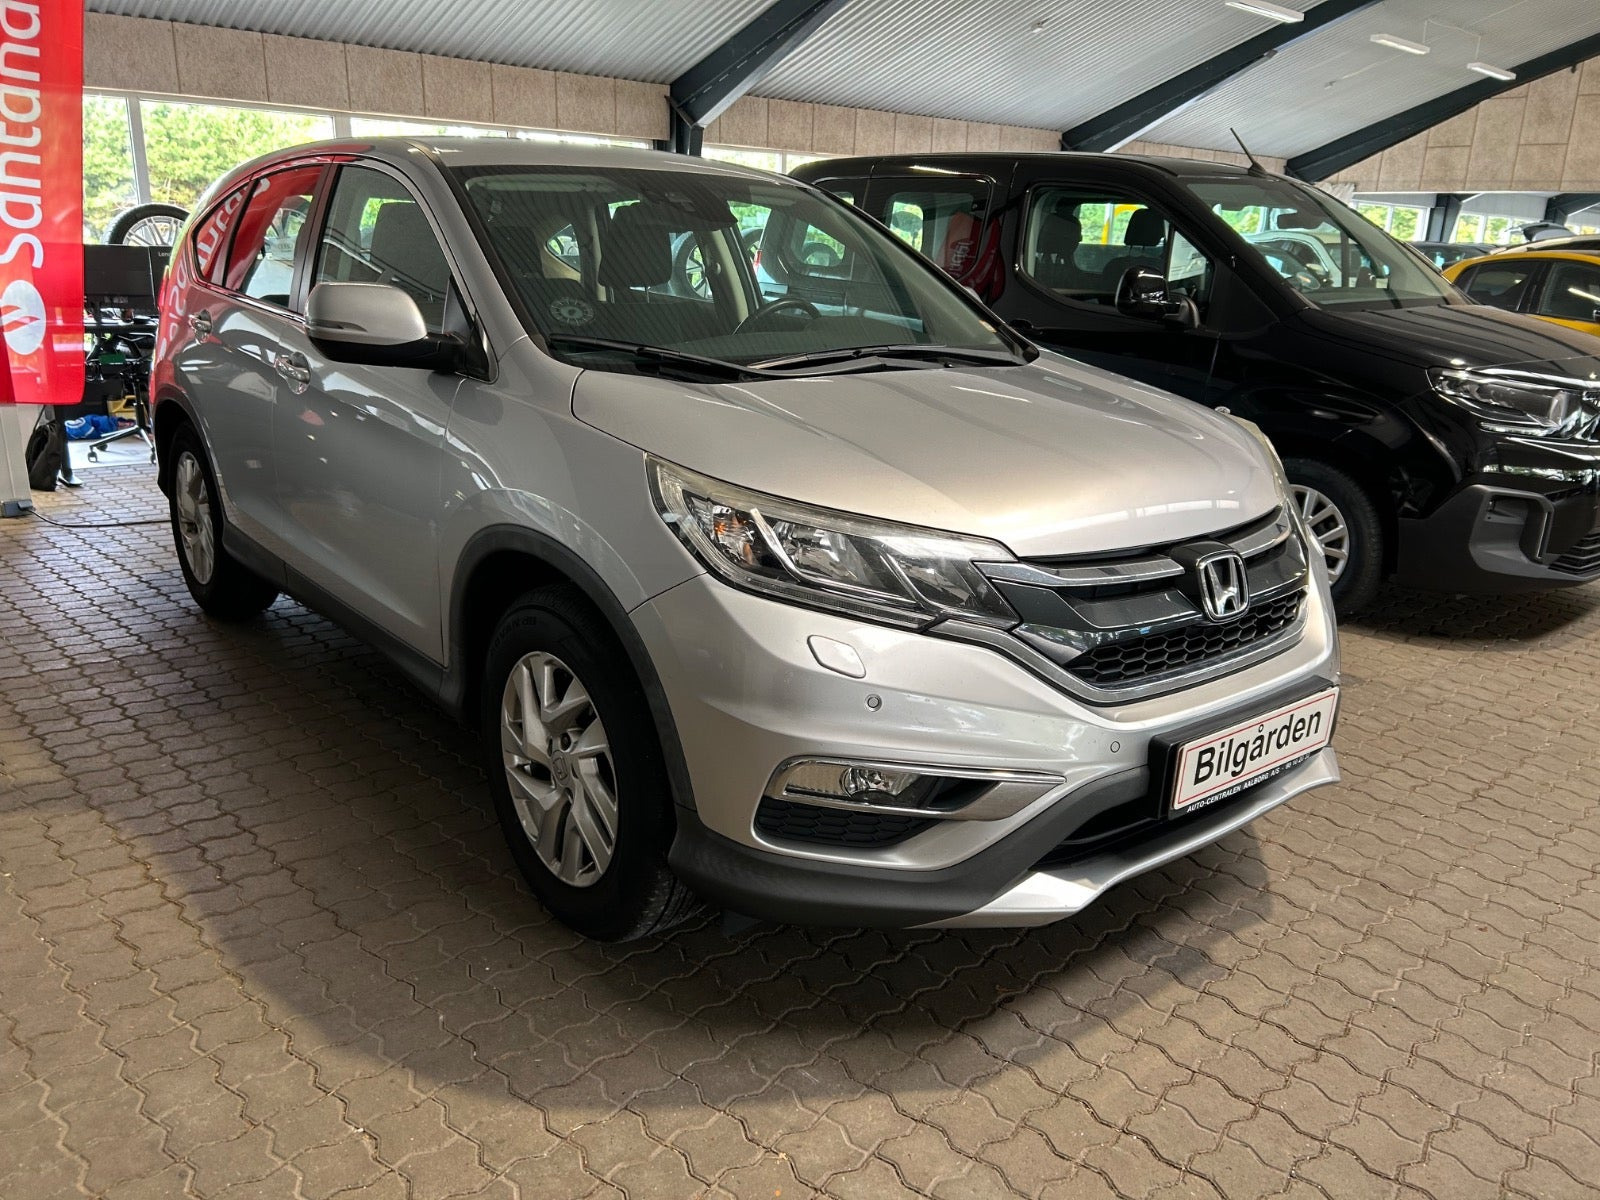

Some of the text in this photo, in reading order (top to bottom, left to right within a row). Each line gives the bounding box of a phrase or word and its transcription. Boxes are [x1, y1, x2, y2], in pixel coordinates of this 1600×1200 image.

[1193, 711, 1321, 786] Bilgården
[1186, 785, 1241, 813] AUTO-CENTRALEN
[1243, 772, 1269, 789] AALBORG
